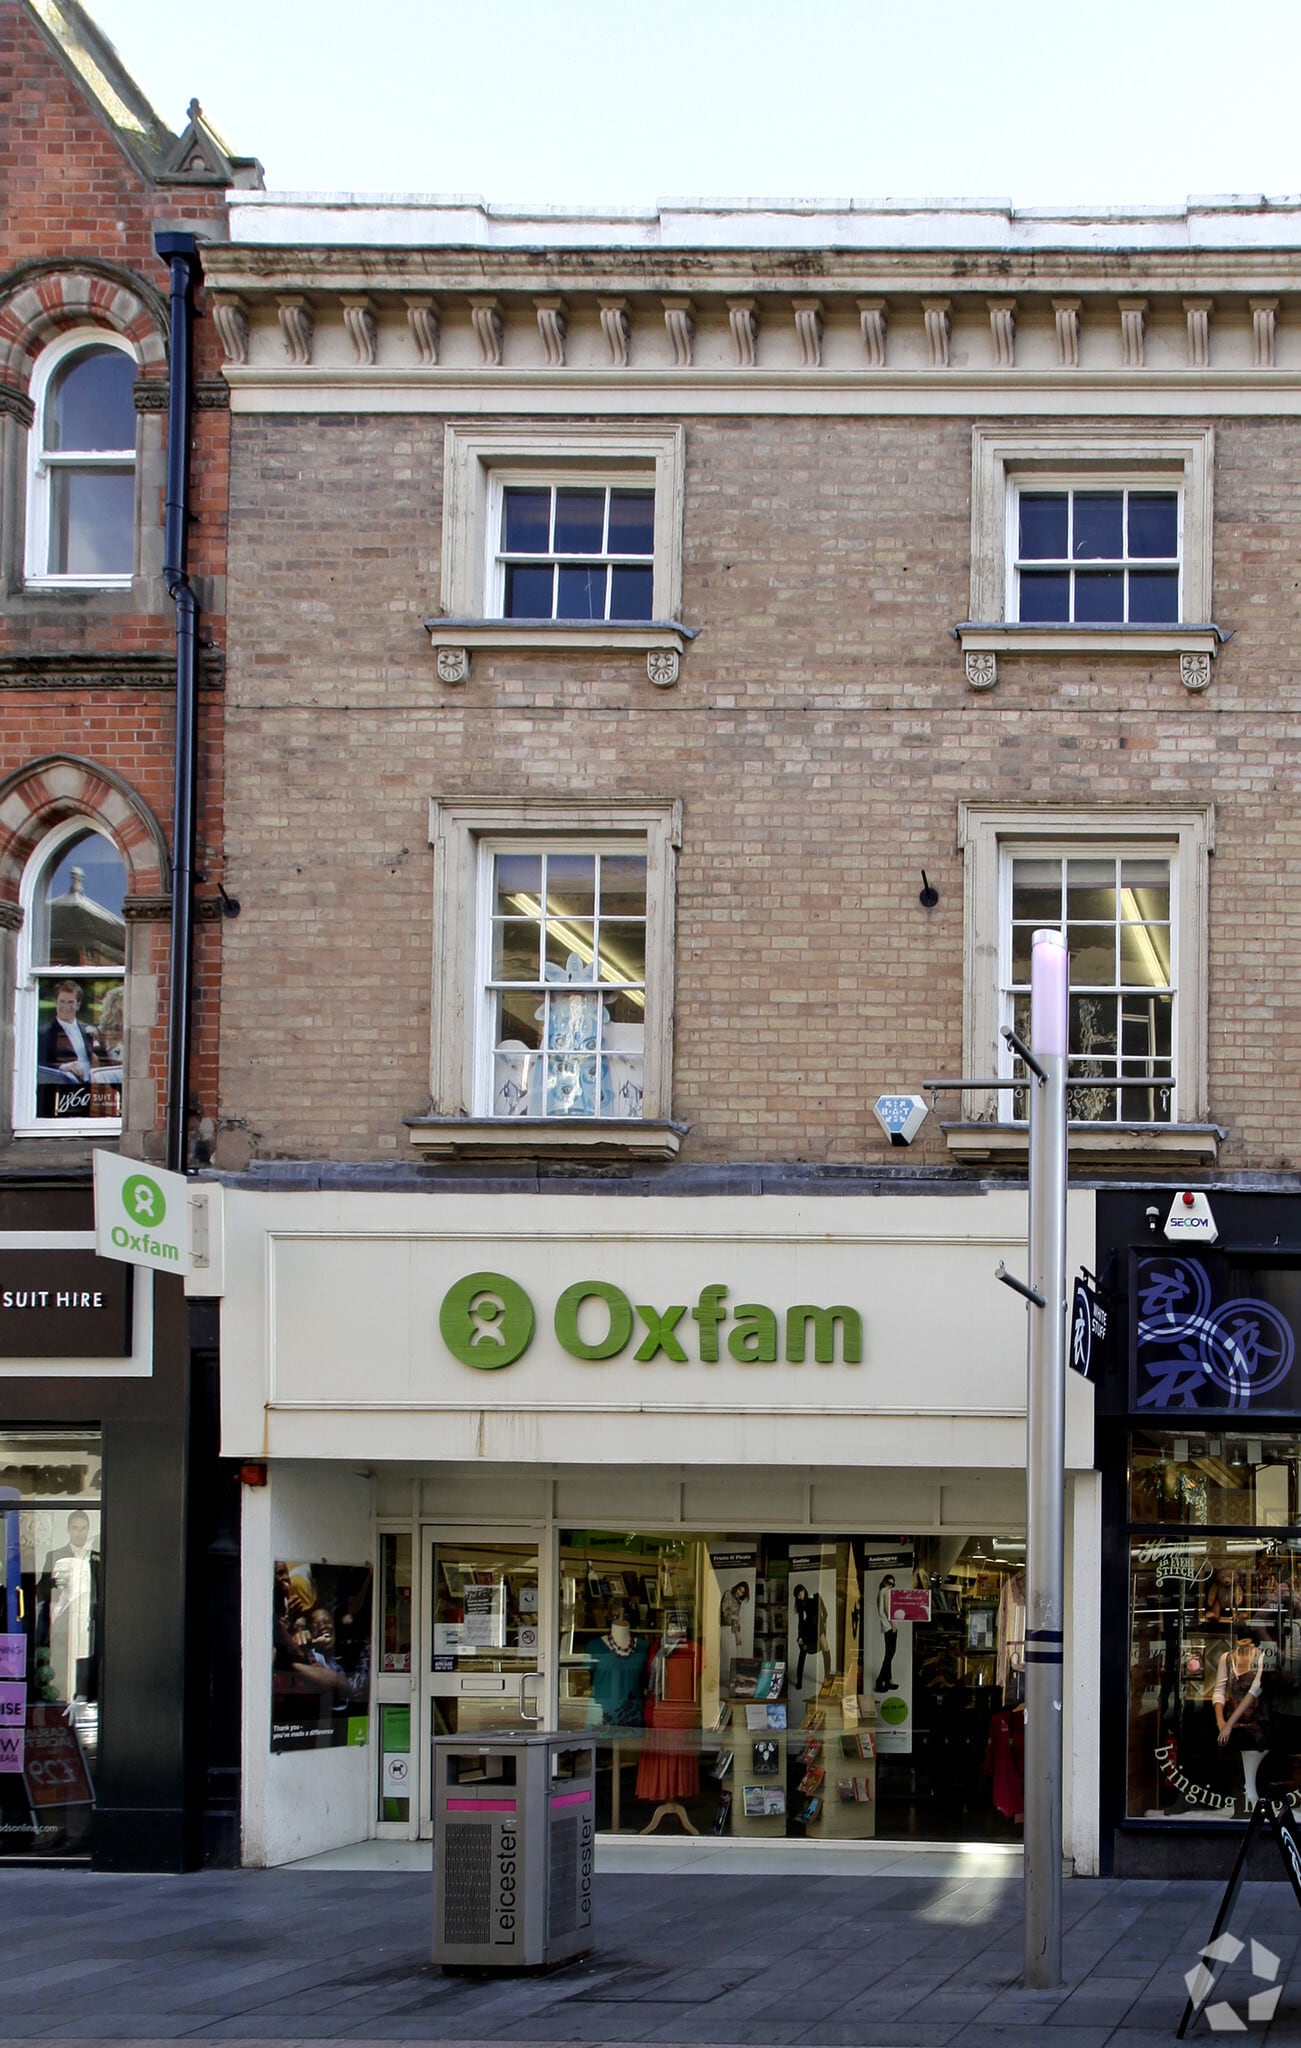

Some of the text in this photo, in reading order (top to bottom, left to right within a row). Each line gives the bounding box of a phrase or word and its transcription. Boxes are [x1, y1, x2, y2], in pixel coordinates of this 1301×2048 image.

[92, 1093, 112, 1102] SUIT
[1170, 1217, 1209, 1228] SECOM
[111, 1226, 179, 1261] Oxfam
[3, 1291, 103, 1308] SUIT HIRE
[554, 1280, 862, 1363] Oxfam
[1093, 1302, 1107, 1326] WHITE
[1092, 1318, 1106, 1340] STUFF
[1156, 1566, 1194, 1578] STITCH
[1154, 1743, 1237, 1808] bringing
[495, 1824, 517, 1945] Leicester
[578, 1815, 592, 1930] Leicester
